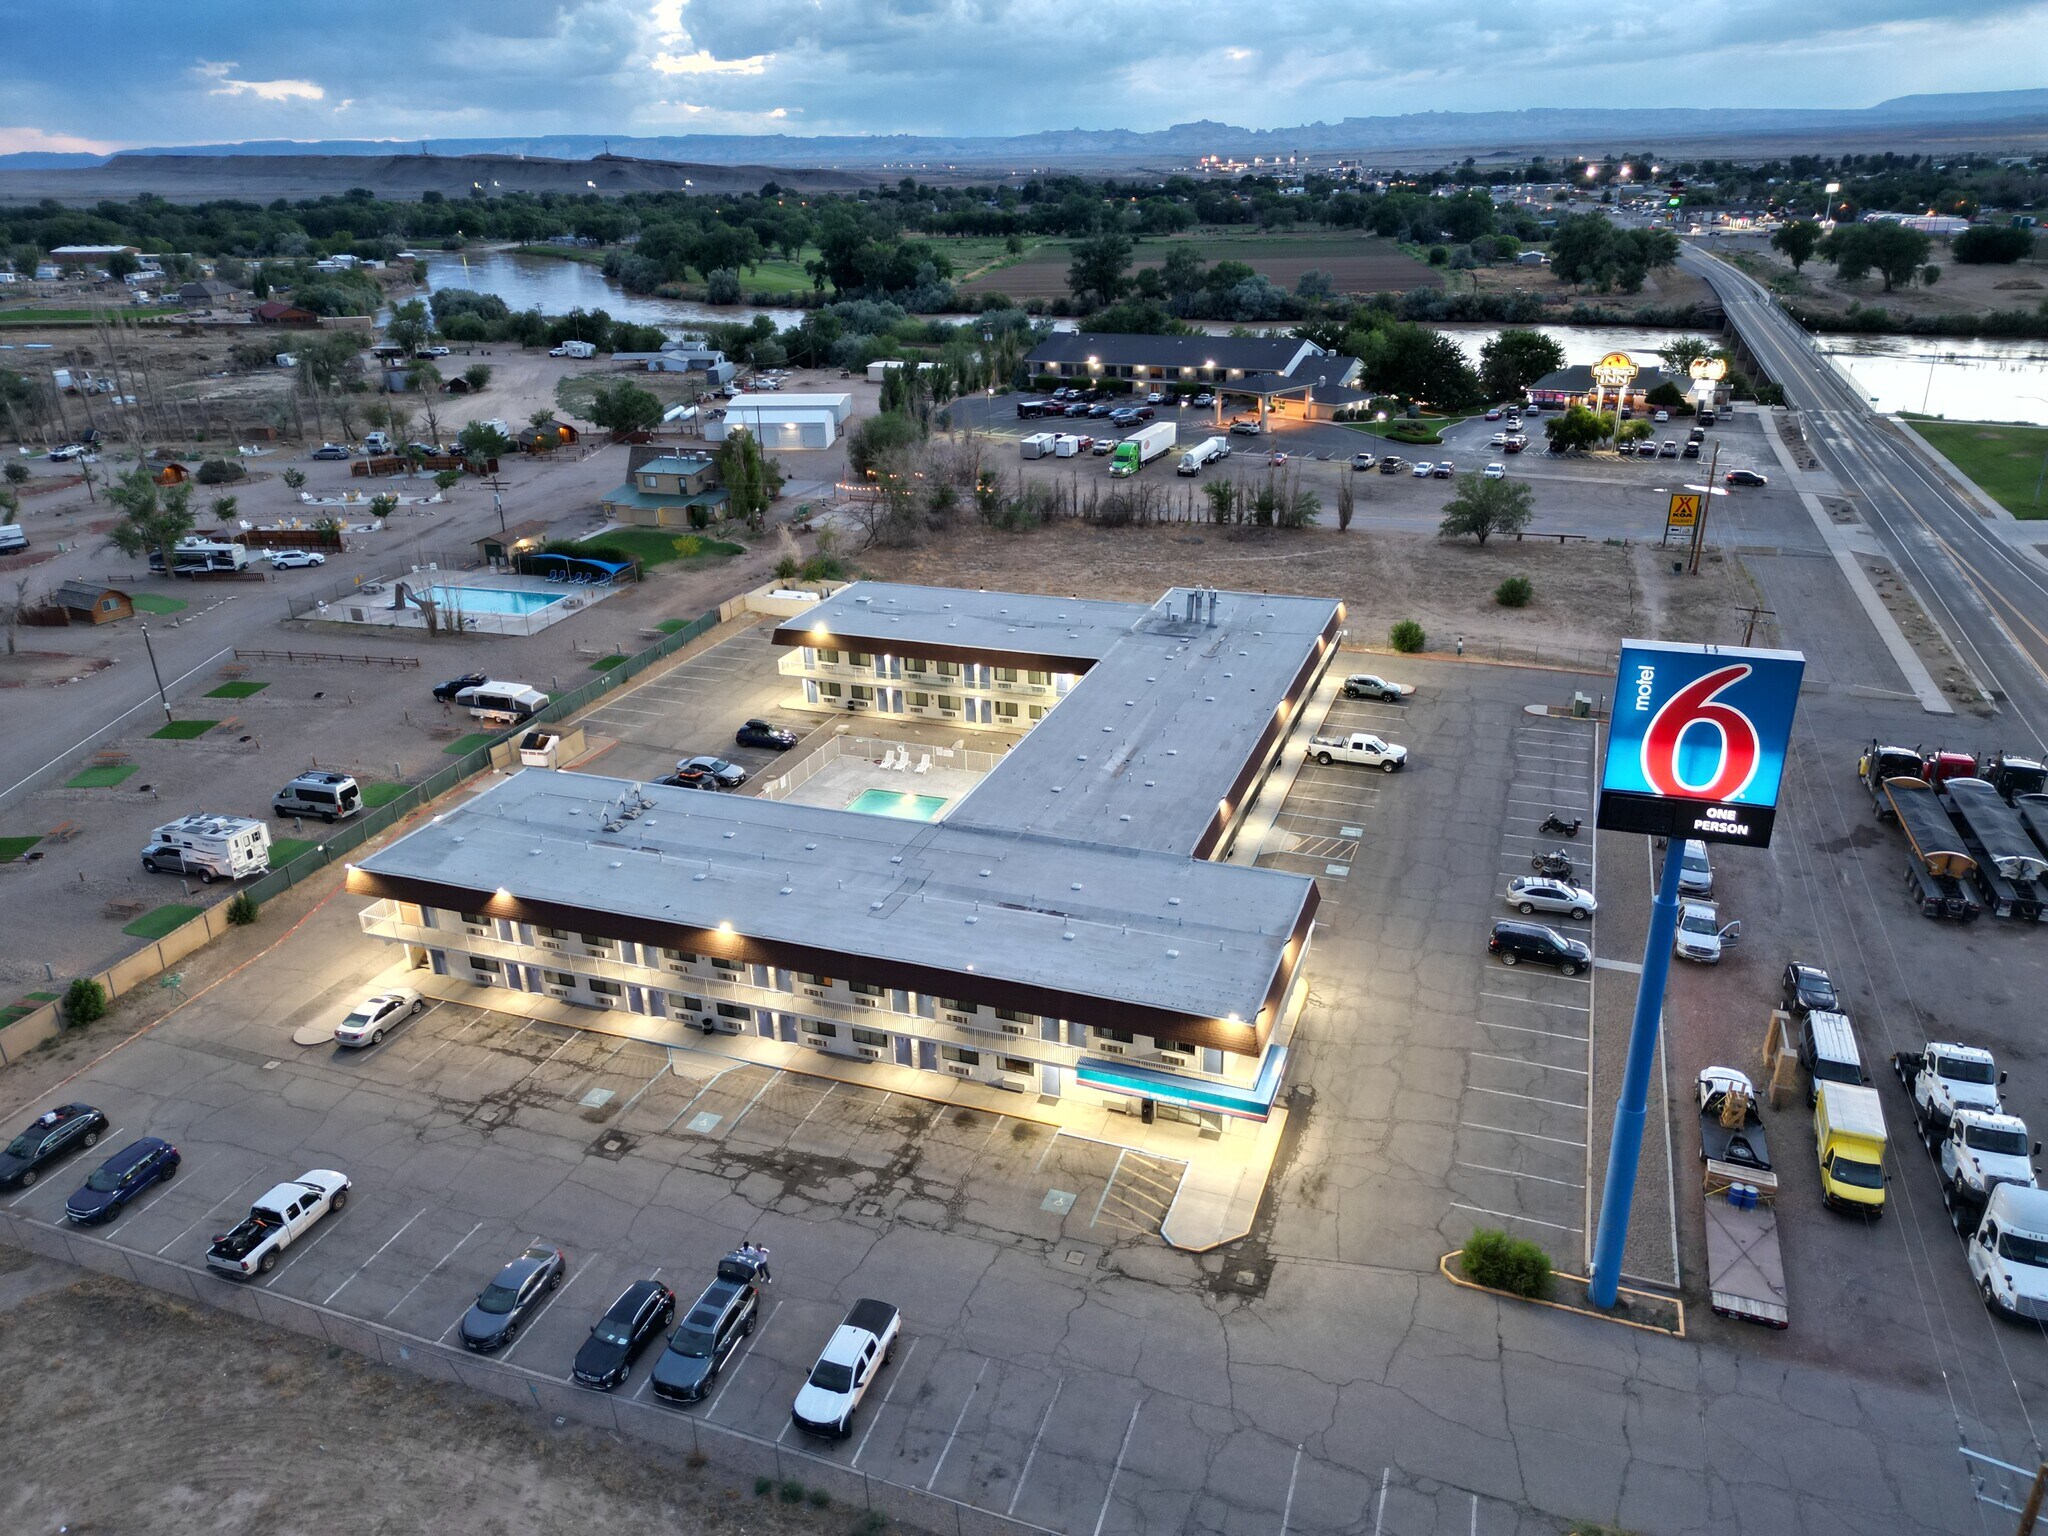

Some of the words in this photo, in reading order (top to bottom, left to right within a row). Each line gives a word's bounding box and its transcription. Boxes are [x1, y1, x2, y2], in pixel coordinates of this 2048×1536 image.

[1600, 375, 1628, 384] INN
[1635, 665, 1655, 711] motel
[1640, 663, 1761, 802] 6
[1706, 807, 1737, 820] ONE
[1693, 819, 1749, 835] PERSON
